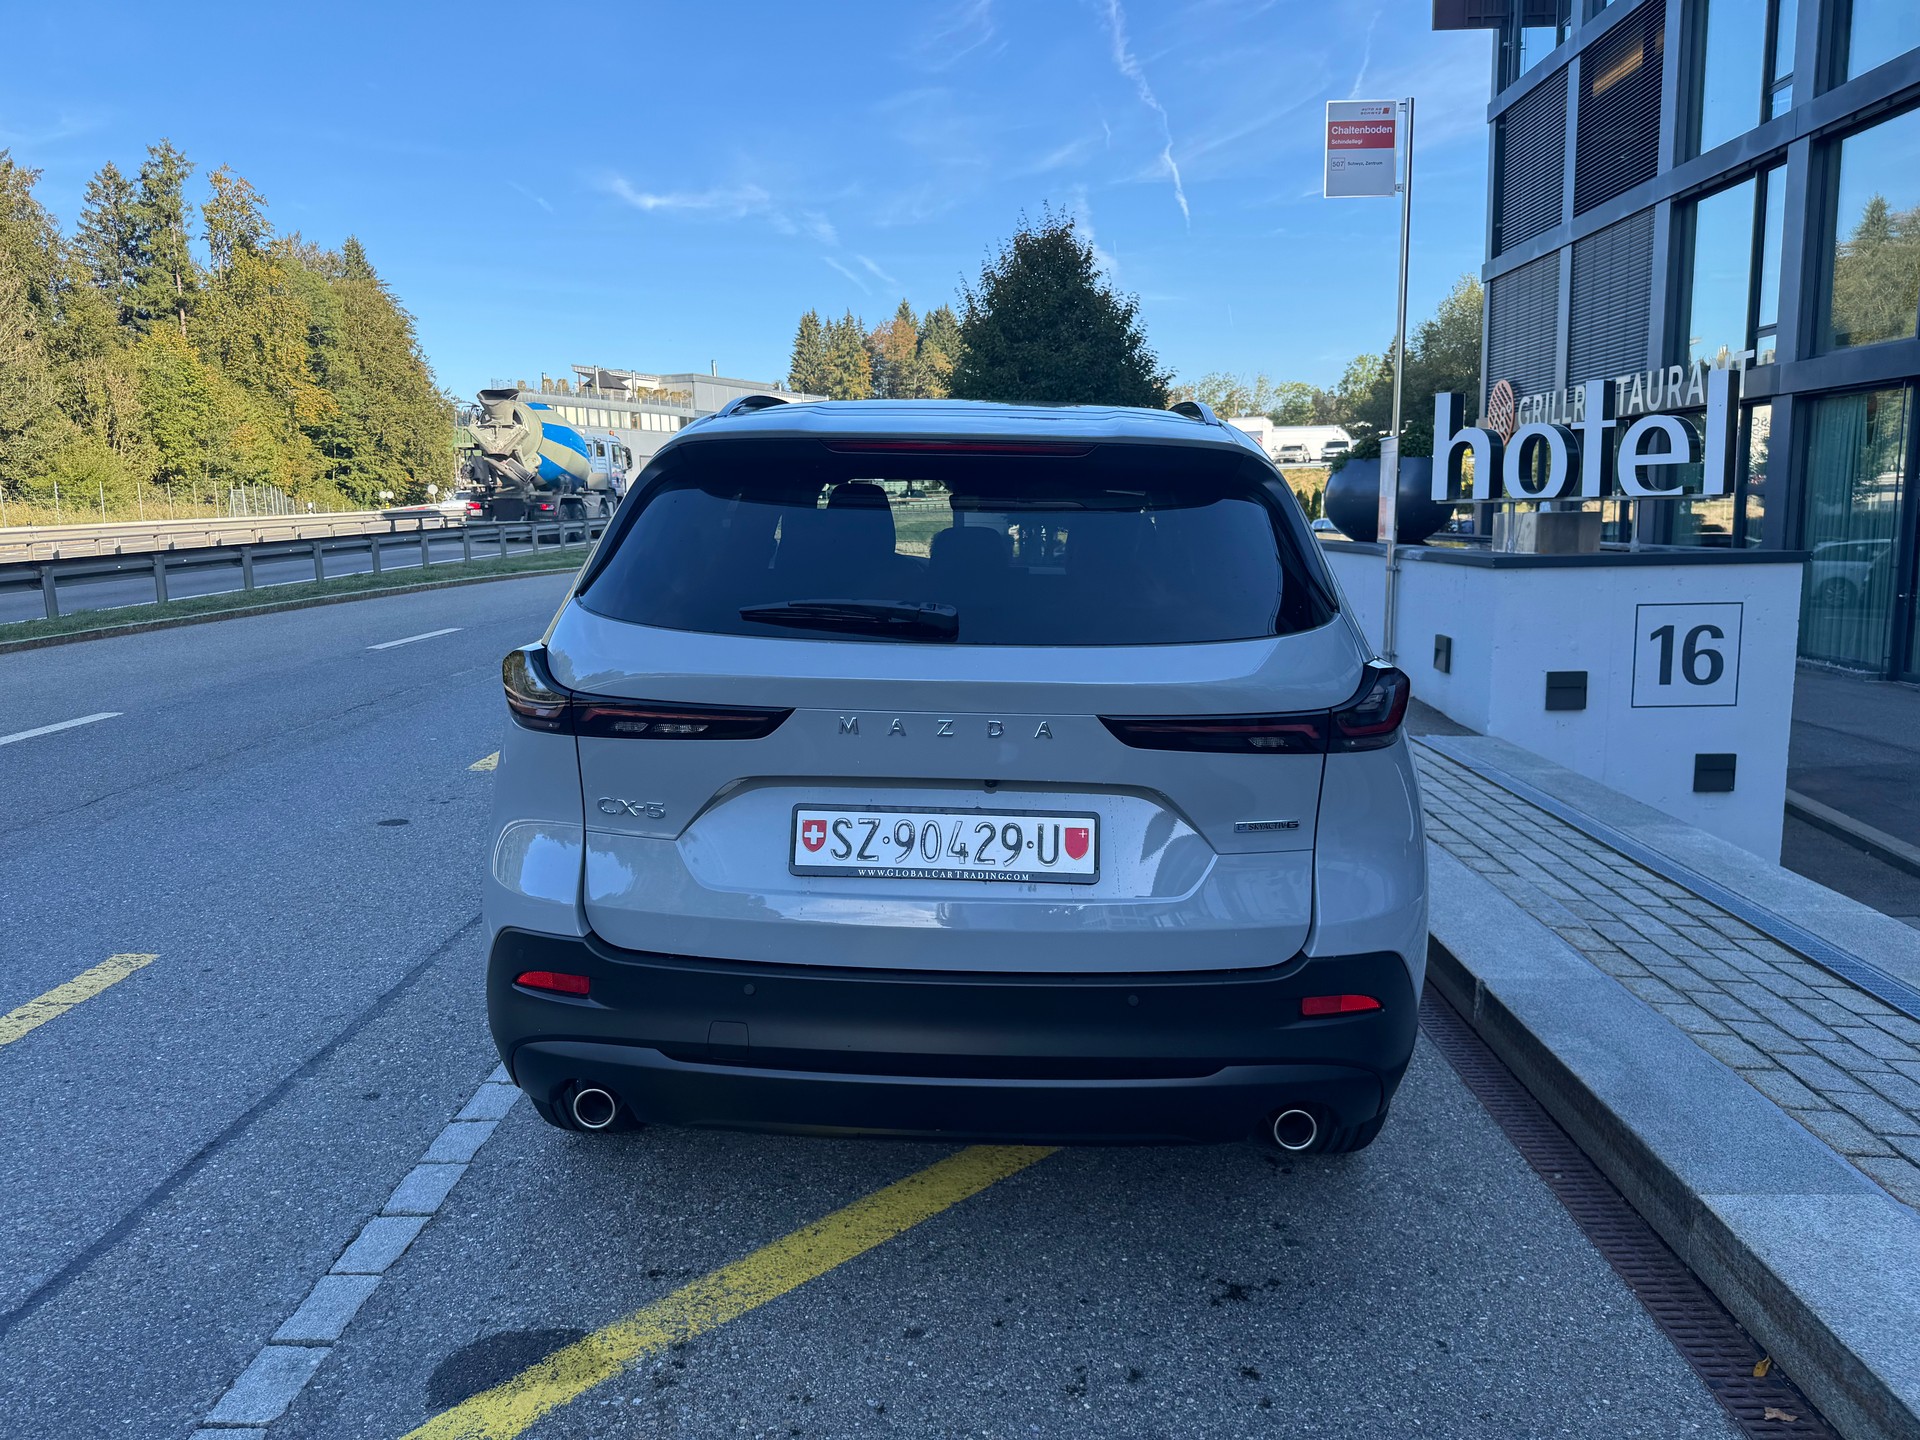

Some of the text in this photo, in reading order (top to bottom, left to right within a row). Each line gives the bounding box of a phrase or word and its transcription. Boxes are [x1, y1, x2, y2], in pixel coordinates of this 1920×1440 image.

[1332, 126, 1392, 134] Chaltenboden
[1431, 369, 1734, 500] hotel
[1650, 624, 1724, 686] 16
[838, 715, 1054, 739] MAZDA
[597, 797, 666, 819] CX-5
